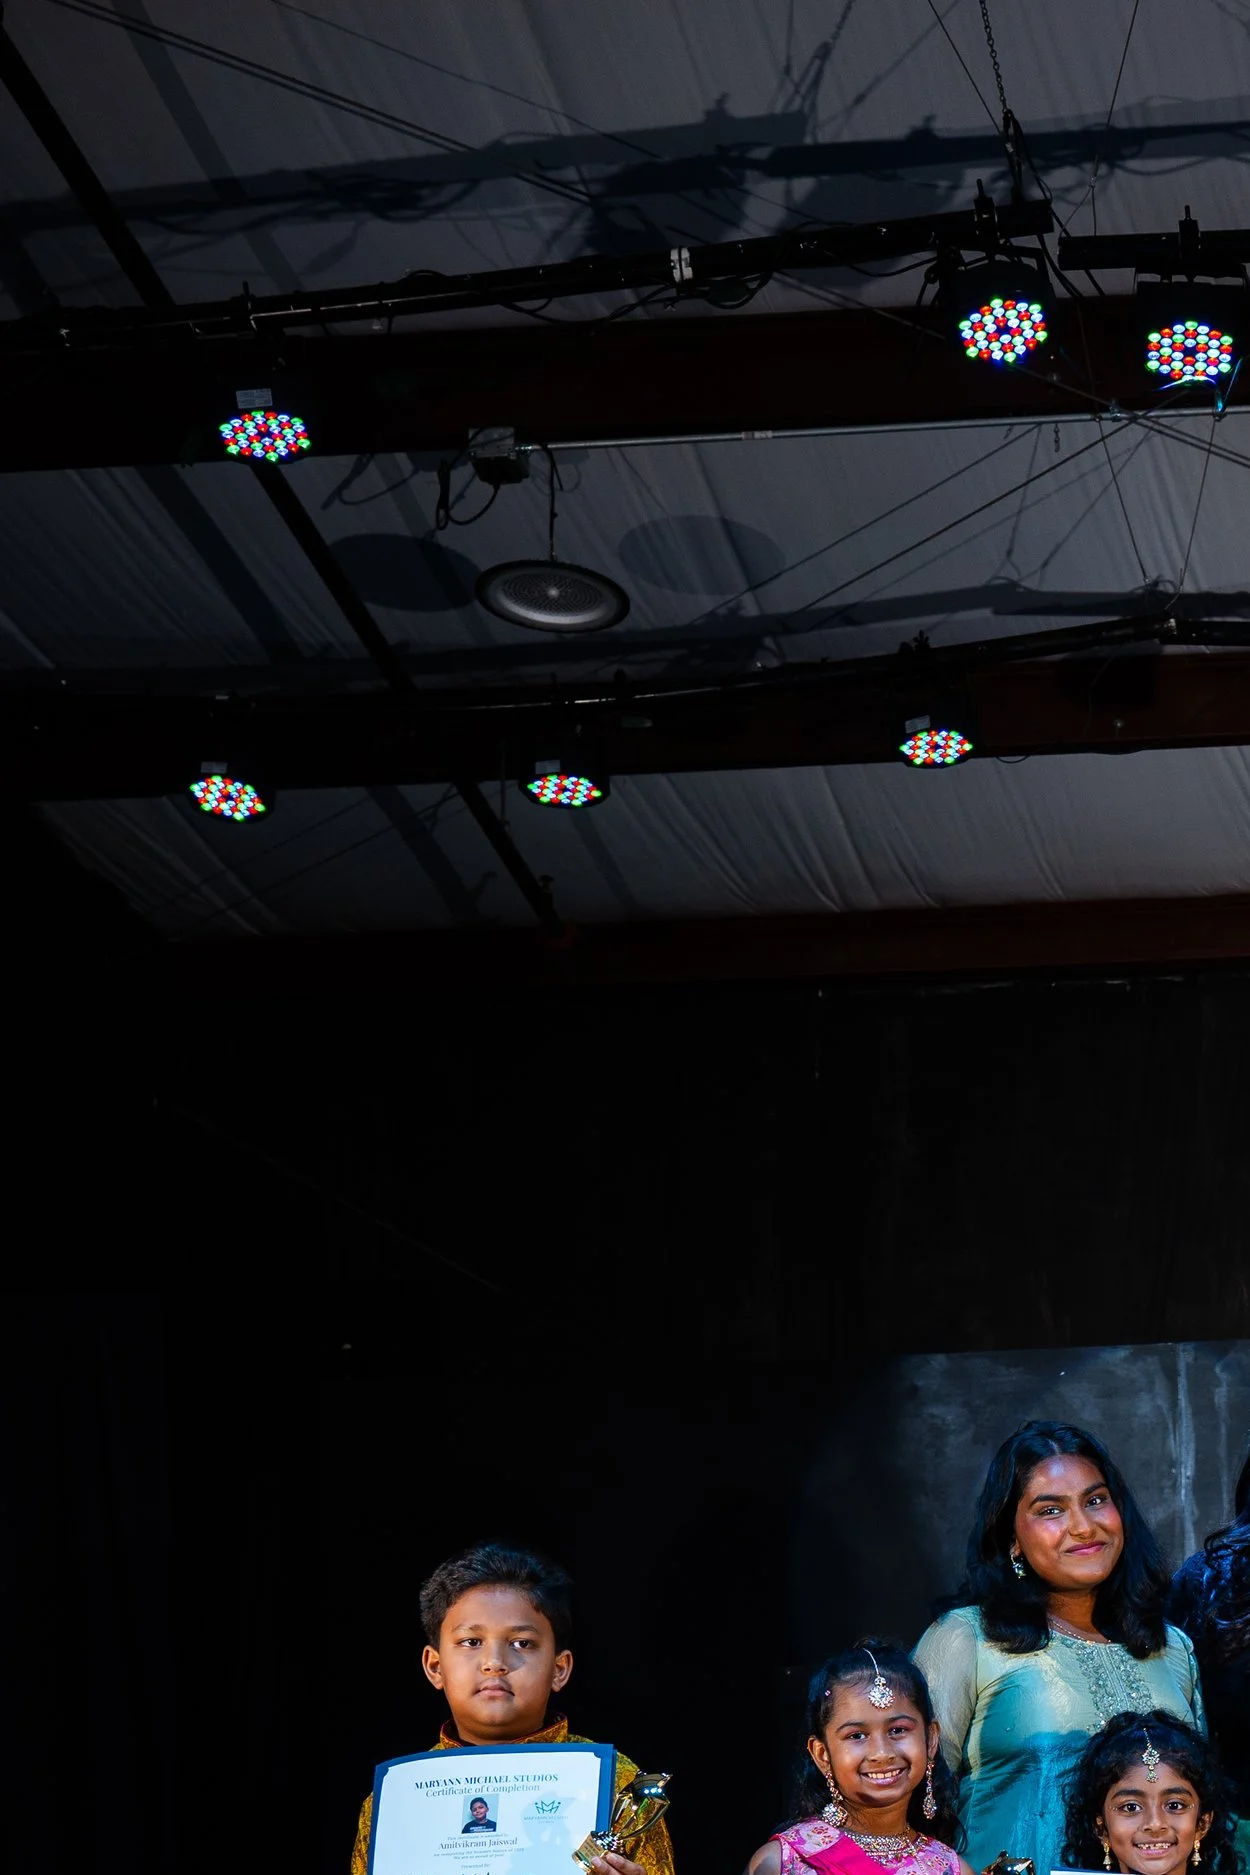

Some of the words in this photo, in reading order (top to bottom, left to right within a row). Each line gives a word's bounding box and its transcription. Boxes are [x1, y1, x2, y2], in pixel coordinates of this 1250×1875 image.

[415, 1777, 461, 1789] MARYANN
[465, 1775, 511, 1785] MICHAEL
[514, 1774, 558, 1782] STUDIOS
[426, 1785, 472, 1797] Certificate
[475, 1785, 485, 1793] of
[486, 1784, 540, 1792] Completion
[439, 1839, 486, 1849] Amitvikram
[489, 1837, 517, 1848] Jaiswal
